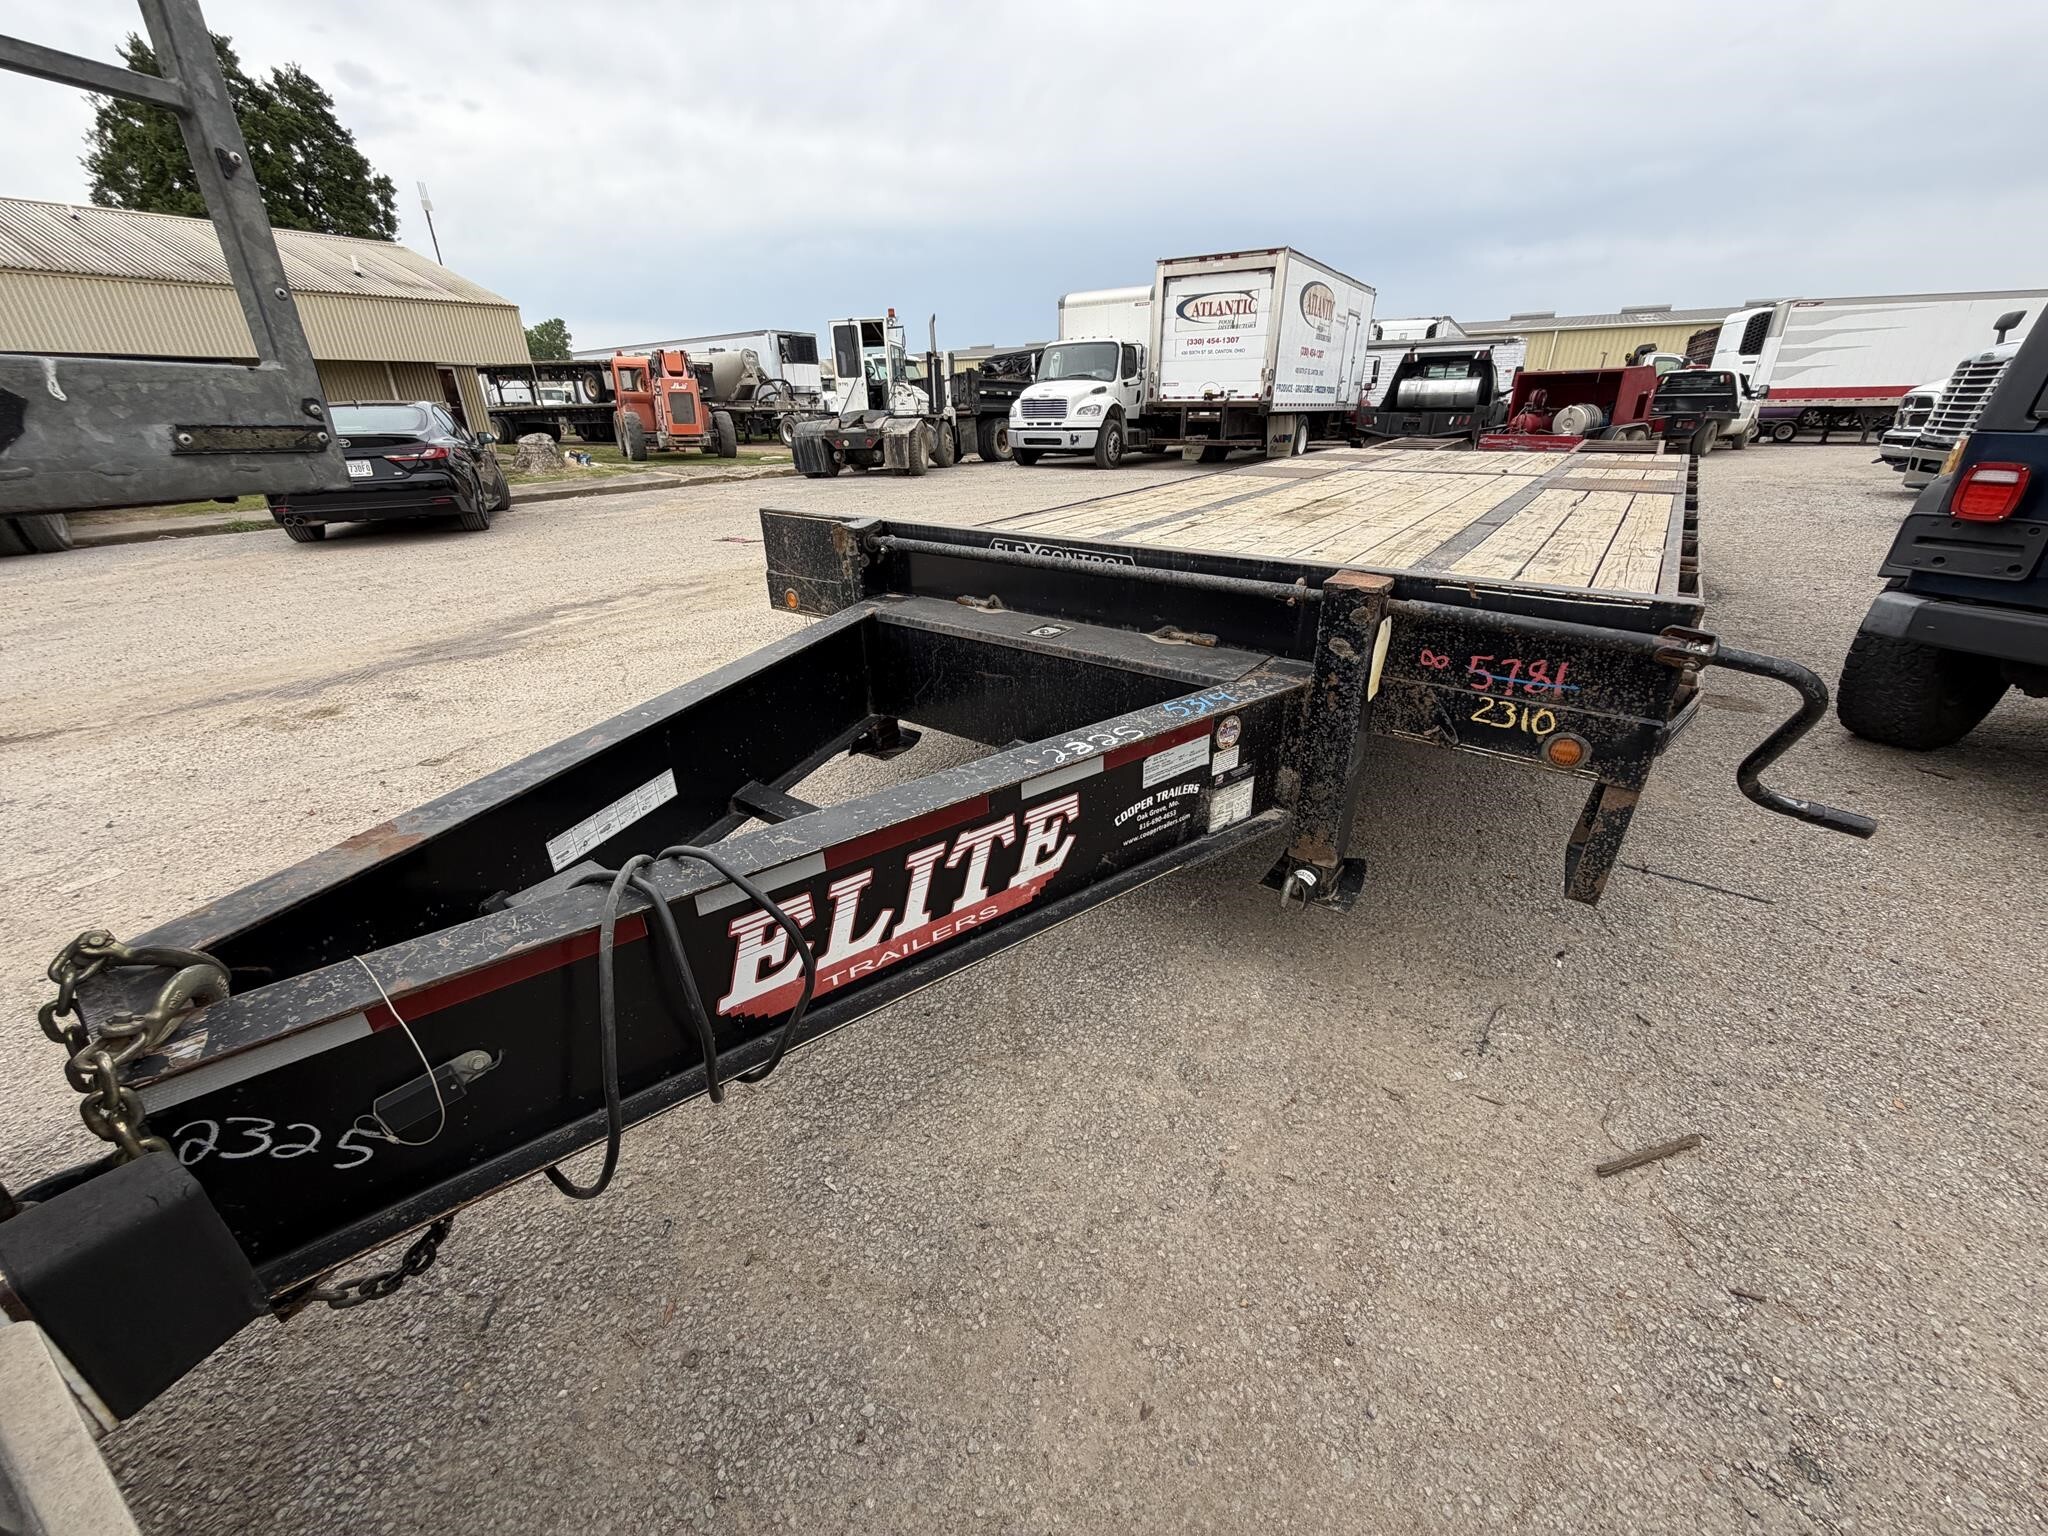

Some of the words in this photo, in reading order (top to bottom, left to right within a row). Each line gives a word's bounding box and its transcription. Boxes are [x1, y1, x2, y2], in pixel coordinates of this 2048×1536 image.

[1191, 299, 1257, 317] ATLANTIC
[1187, 338, 1204, 346] (330)
[1207, 336, 1240, 344] 454-1307
[1468, 655, 1570, 697] 5781
[1471, 697, 1556, 735] 2310
[1114, 794, 1153, 827] COOPER
[1156, 783, 1200, 802] TRAILERS
[1136, 810, 1148, 821] Oak
[1149, 804, 1167, 817] Grove,
[1168, 800, 1180, 809] Mo.
[1139, 809, 1177, 831] 816-690-4653
[1122, 813, 1191, 846] www.coopertrailers.com
[716, 792, 1080, 1015] ELITE
[822, 904, 999, 986] TRAILERS
[172, 1117, 381, 1169] 2325
